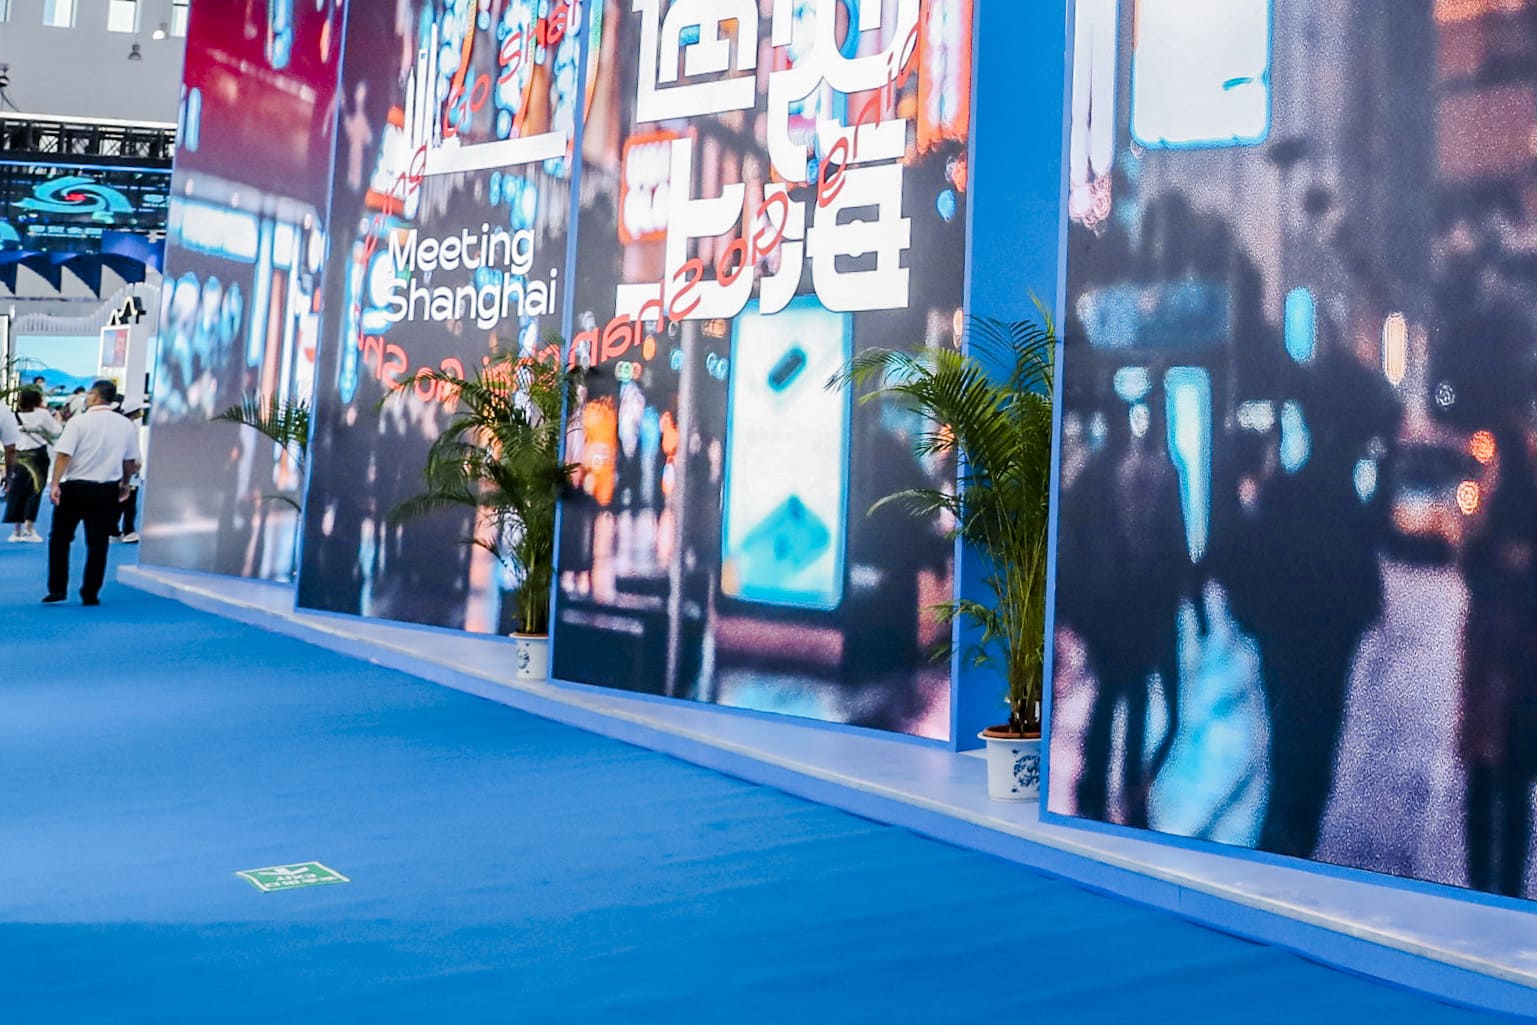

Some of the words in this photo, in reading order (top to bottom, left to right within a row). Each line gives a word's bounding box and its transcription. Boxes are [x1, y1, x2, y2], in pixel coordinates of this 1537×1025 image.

[388, 222, 536, 276] Meeting
[615, 119, 913, 320] 上海
[384, 267, 559, 331] Shanghai
